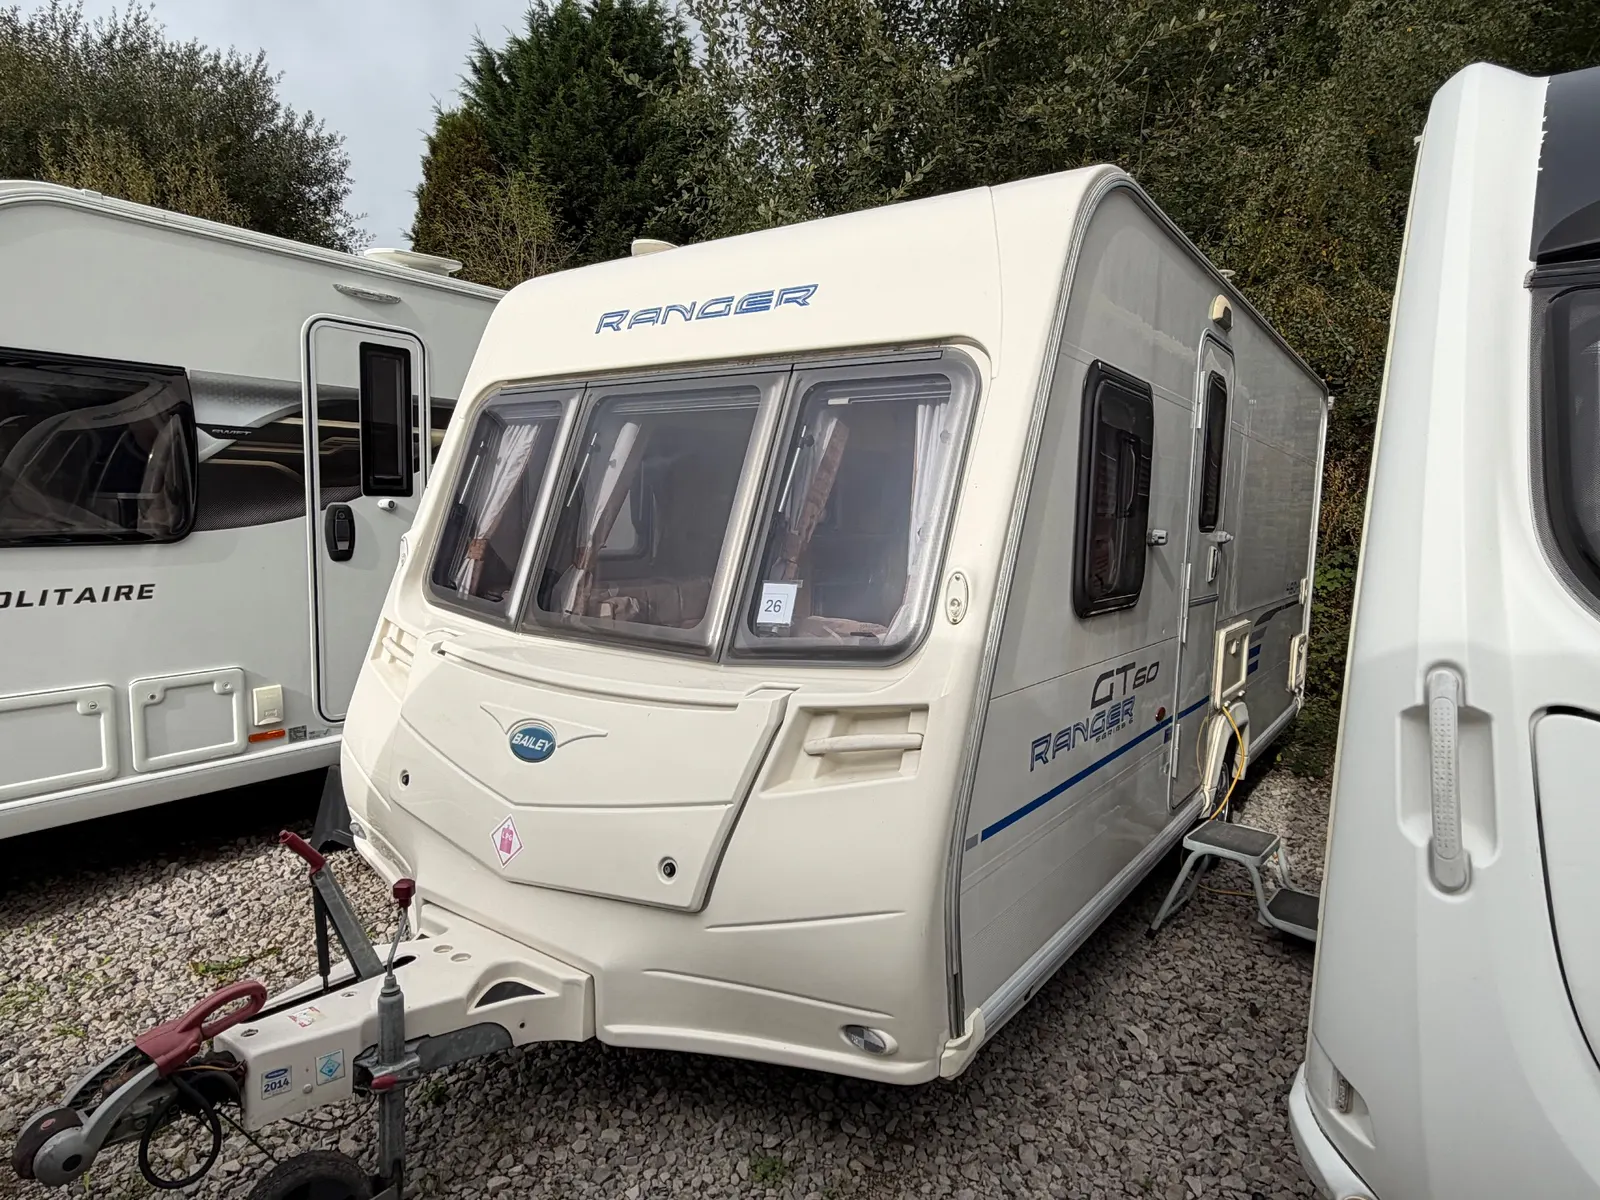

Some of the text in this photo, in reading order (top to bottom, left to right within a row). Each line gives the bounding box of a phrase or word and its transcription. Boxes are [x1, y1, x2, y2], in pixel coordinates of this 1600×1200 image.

[595, 284, 819, 334] RANGER
[764, 599, 783, 613] 26
[1090, 661, 1160, 710] GT60
[511, 733, 554, 752] BAILEY
[1030, 695, 1136, 772] RANGER
[502, 831, 513, 842] LPG
[264, 1078, 290, 1093] 2014
